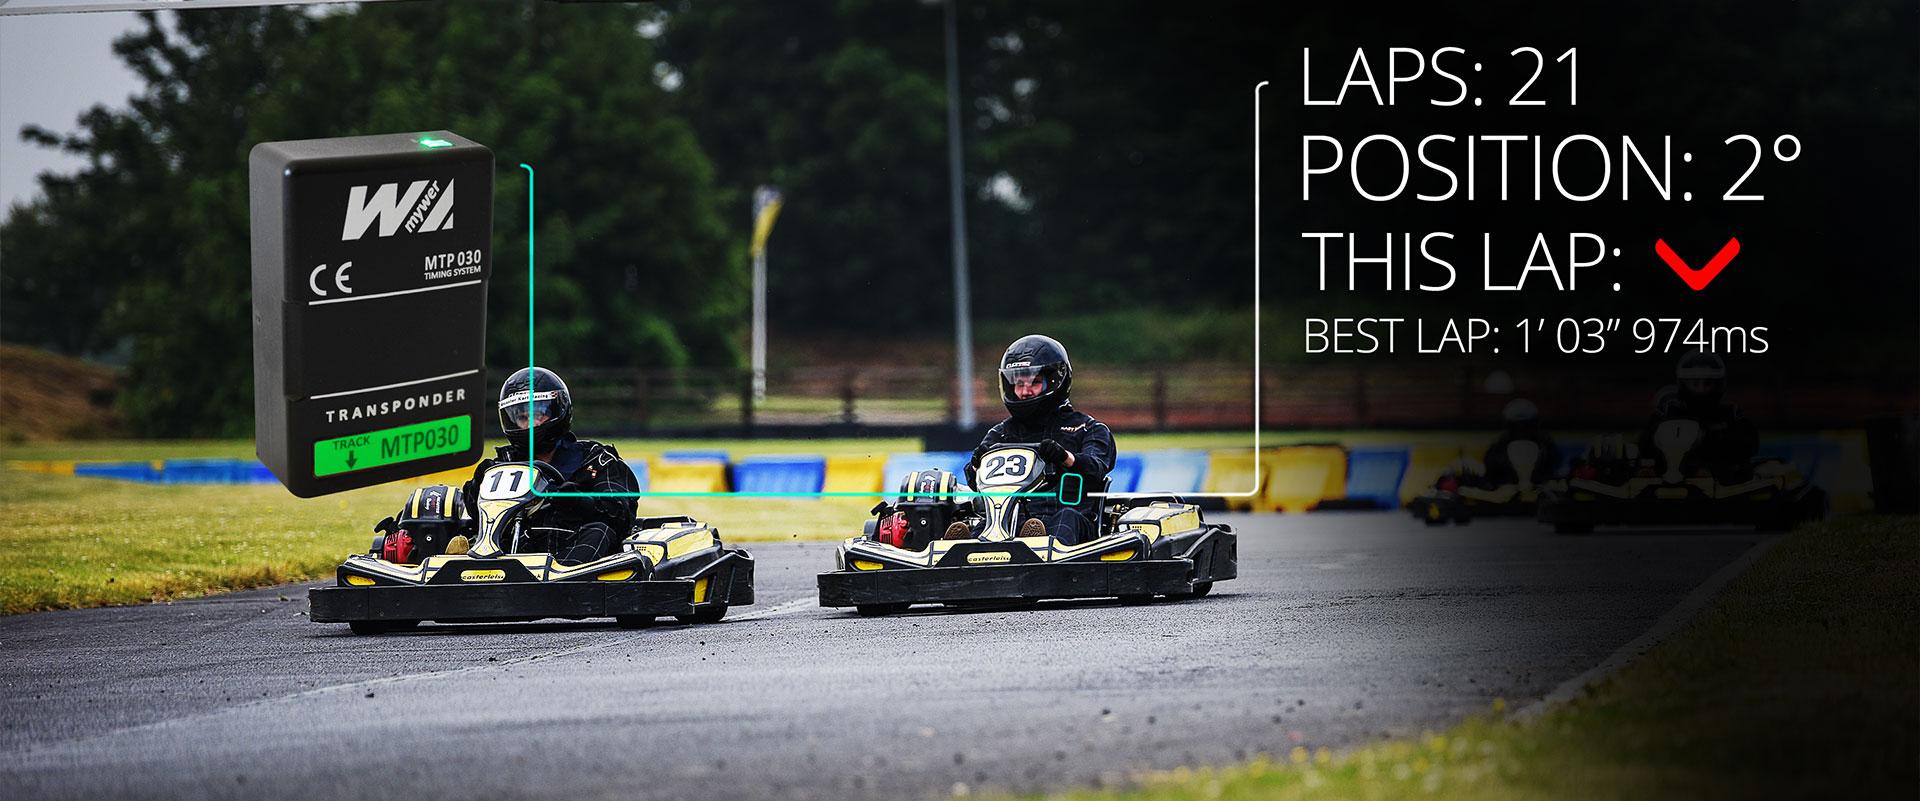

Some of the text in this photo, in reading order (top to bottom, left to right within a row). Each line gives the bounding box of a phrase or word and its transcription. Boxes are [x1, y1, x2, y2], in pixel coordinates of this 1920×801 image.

[404, 180, 442, 234] mywer
[424, 249, 482, 271] MTP 030
[424, 265, 482, 280] TIMING SYSTEM
[325, 388, 466, 423] TRANSPONDER
[332, 424, 459, 459] TRACK MTP030
[986, 454, 1027, 480] 23
[490, 470, 524, 493] 11
